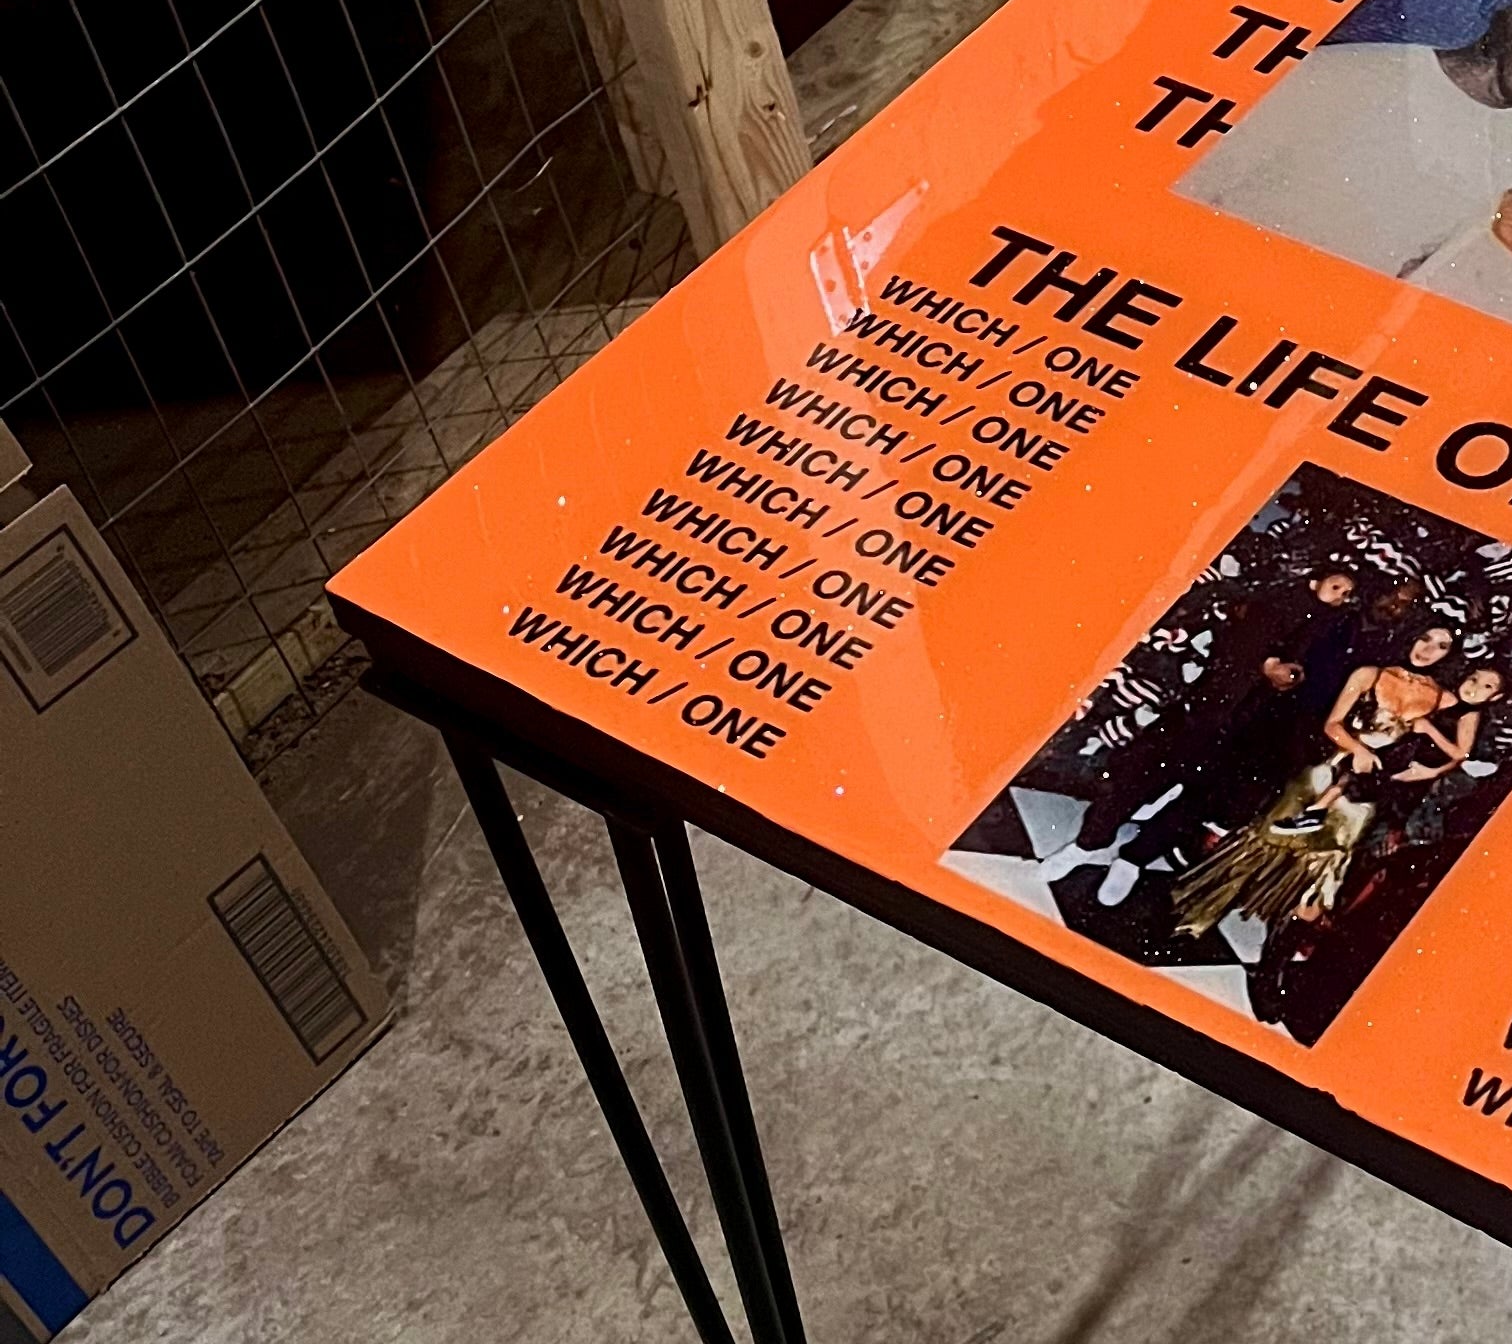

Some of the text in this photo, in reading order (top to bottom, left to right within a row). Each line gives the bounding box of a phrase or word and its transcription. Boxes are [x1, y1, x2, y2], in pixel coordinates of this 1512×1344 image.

[845, 308, 1105, 434] WHICH / ONE
[880, 275, 1140, 398] WHICH / ONE
[969, 226, 1182, 350] THE
[1175, 315, 1428, 452] LIFE
[765, 378, 1031, 510] WHICH / ONE
[806, 343, 1069, 471] WHICH / ONE
[686, 449, 955, 587] WHICH / ONE
[726, 414, 994, 548] WHICH / ONE
[600, 526, 873, 670] WHICH / ONE
[642, 488, 913, 629] WHICH / ONE
[509, 607, 786, 759] WHICH / ONE
[556, 564, 831, 712] WHICH / ONE
[18, 997, 72, 1063] FRAGILE
[56, 995, 204, 1188] FOAM CUSHION FOR DISHES
[64, 1057, 96, 1094] FOR
[106, 1007, 154, 1068] SECURE
[158, 1074, 189, 1114] SEAL
[0, 1015, 156, 1250] DON'T FOR
[86, 1087, 142, 1157] CUSHION
[132, 1152, 181, 1208] BUBBLE
[181, 1109, 201, 1135] TO
[194, 1127, 226, 1168] TAPE
